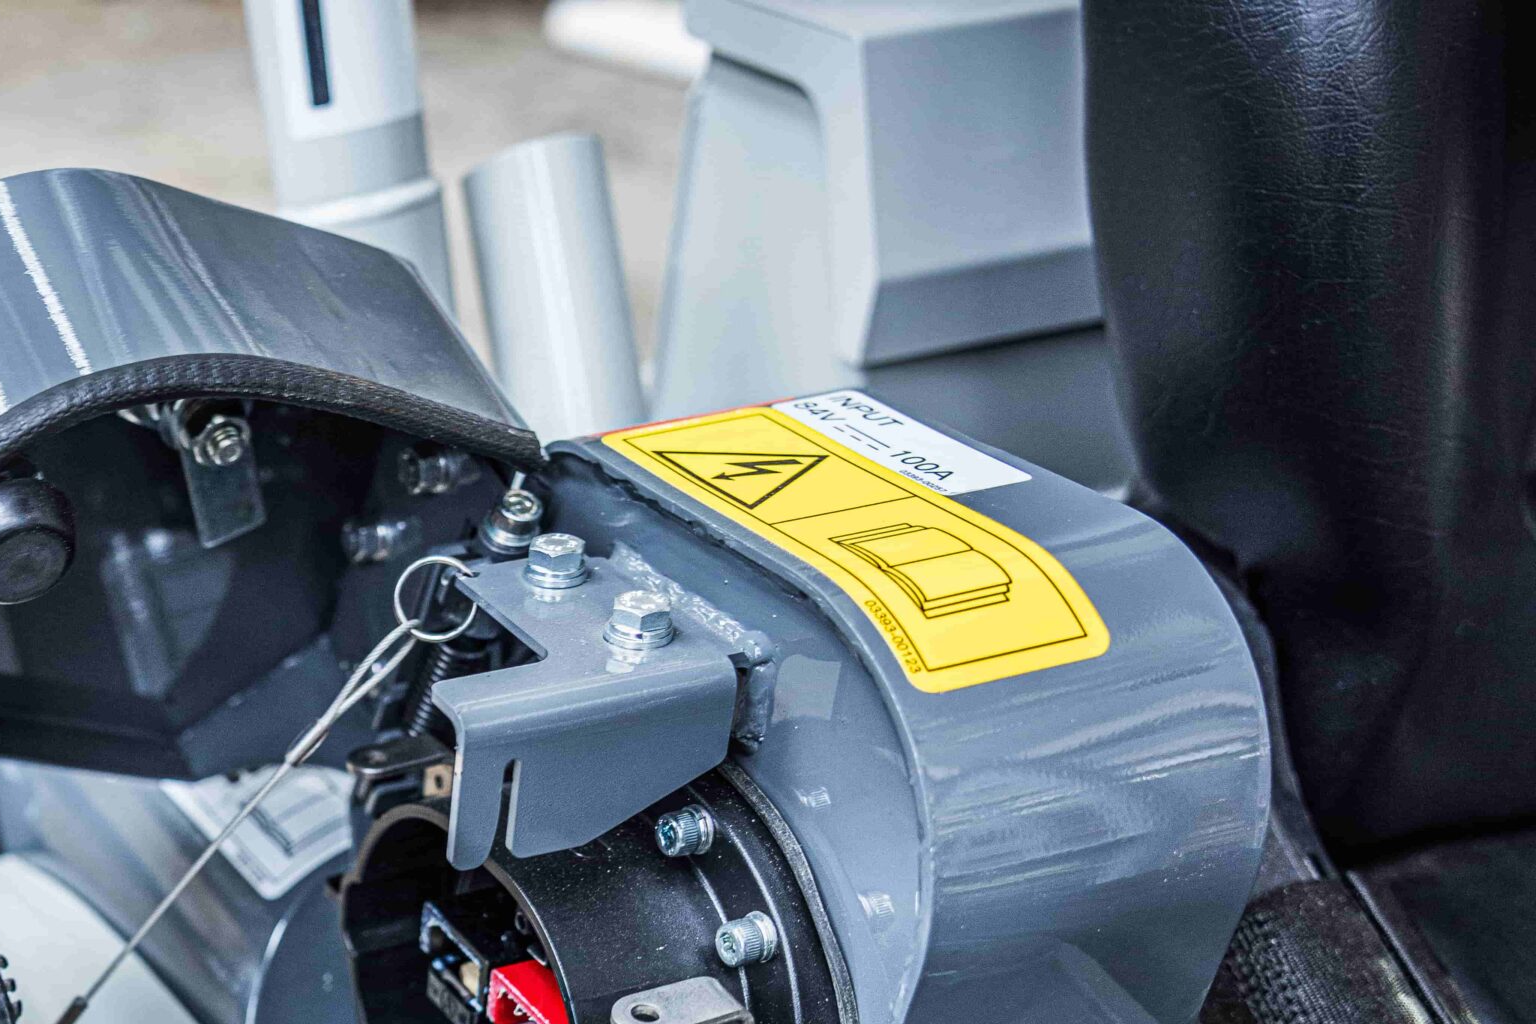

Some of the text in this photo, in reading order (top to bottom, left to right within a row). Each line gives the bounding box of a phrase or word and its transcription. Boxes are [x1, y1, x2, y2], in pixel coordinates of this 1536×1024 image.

[828, 395, 904, 426] INPUT
[890, 450, 954, 481] 100A
[864, 600, 922, 674] 03393-00123
